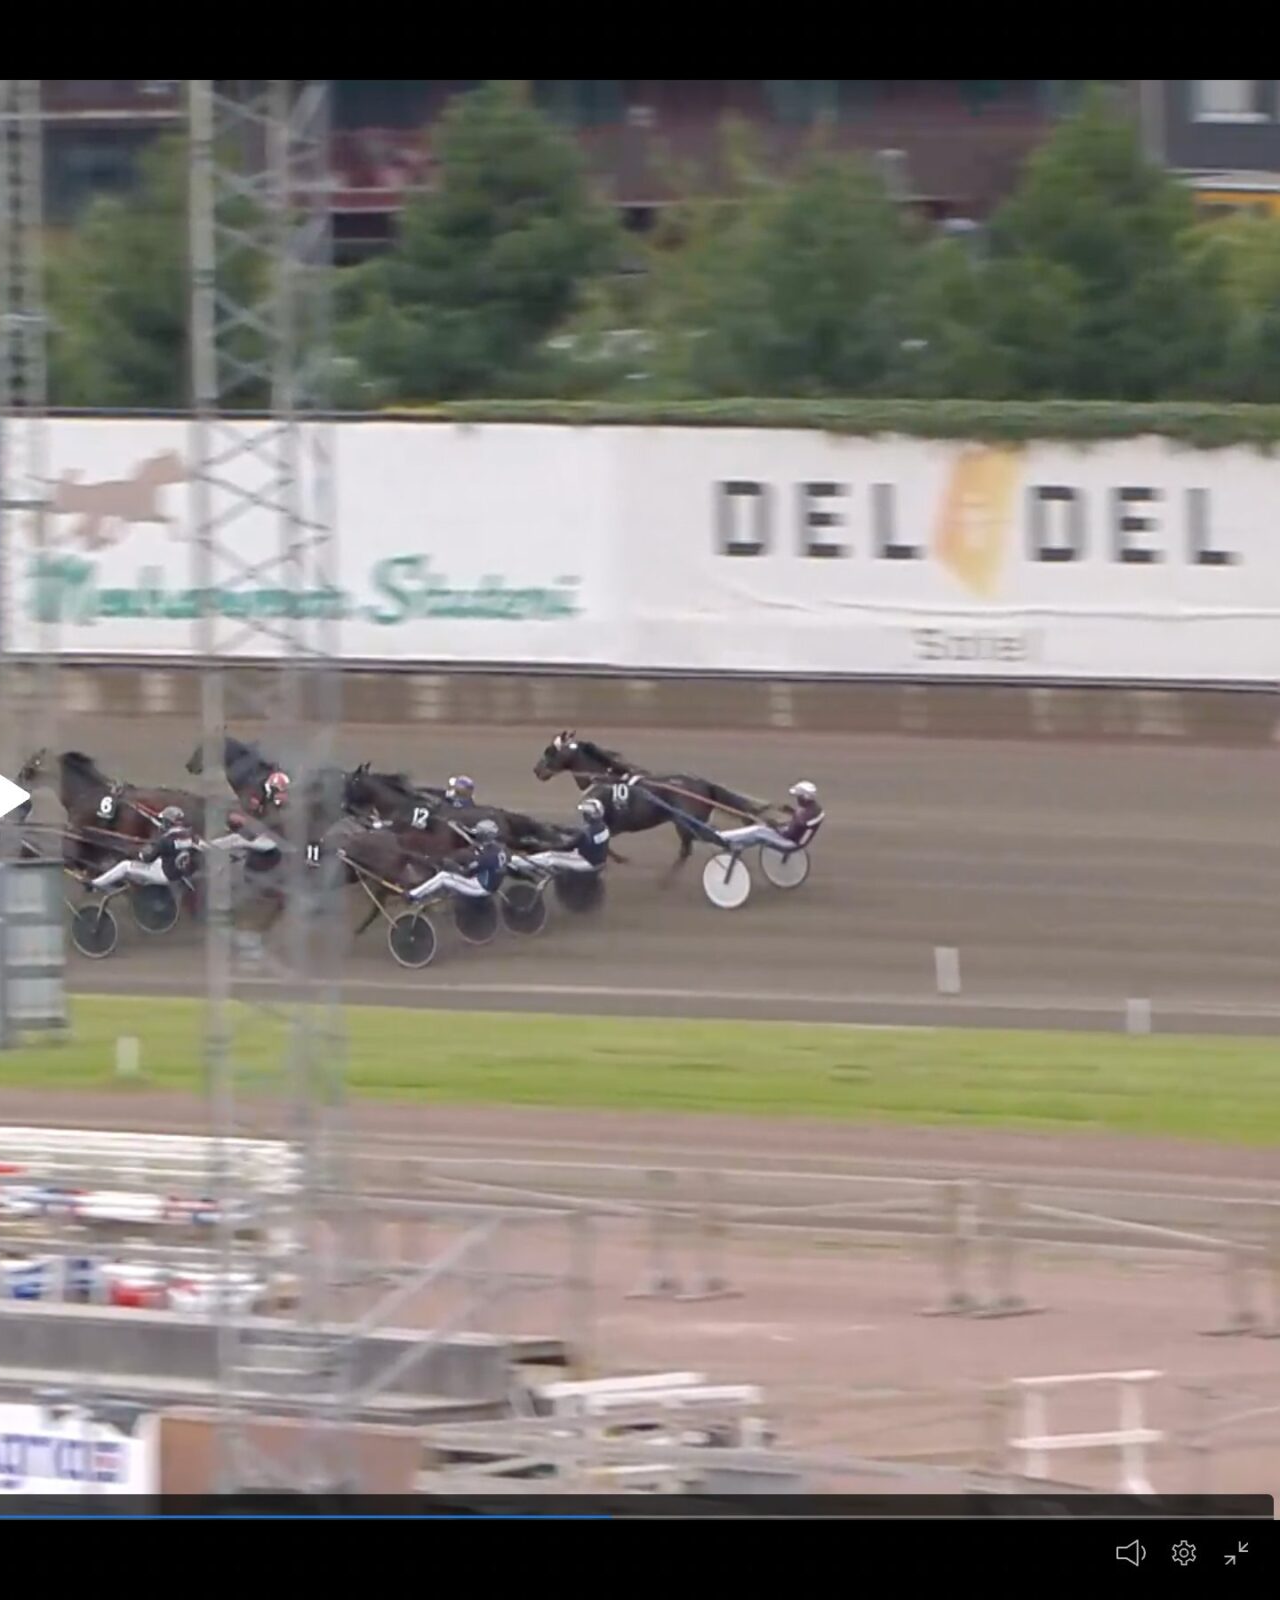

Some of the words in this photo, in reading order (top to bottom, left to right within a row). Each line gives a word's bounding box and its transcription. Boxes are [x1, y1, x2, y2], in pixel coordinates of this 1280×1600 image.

[713, 481, 926, 560] DEL
[1024, 485, 1241, 567] DEL
[612, 783, 628, 801] 10
[100, 796, 113, 813] 6
[412, 807, 429, 825] 12
[307, 844, 319, 861] 11
